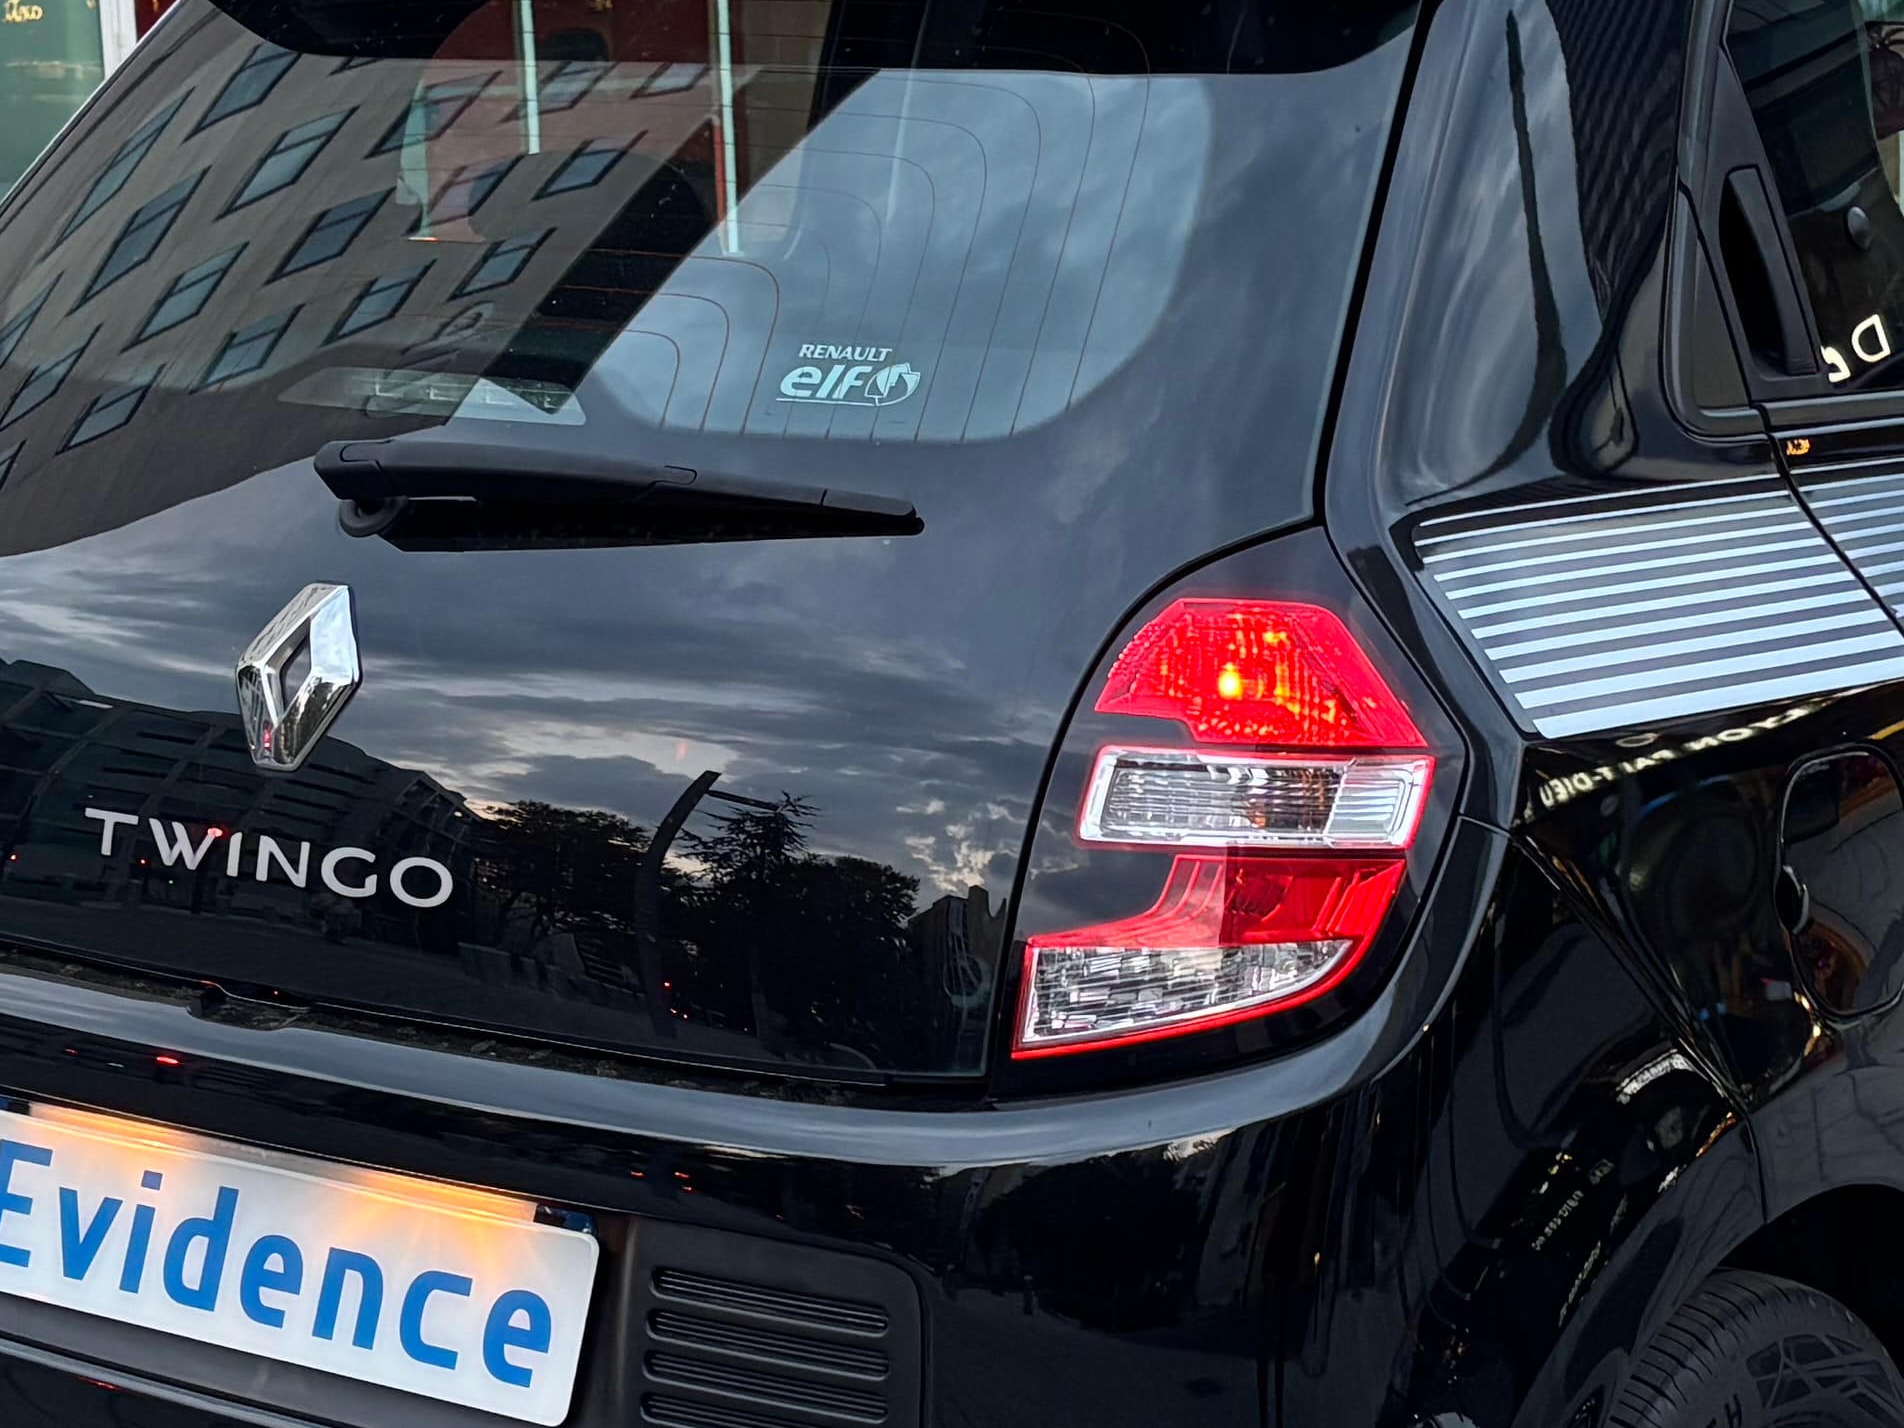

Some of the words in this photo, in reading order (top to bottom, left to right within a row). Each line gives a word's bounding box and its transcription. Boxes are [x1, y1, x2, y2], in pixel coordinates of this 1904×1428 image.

[799, 343, 892, 362] RENAULT
[779, 364, 872, 399] elf
[85, 807, 453, 908] TWINGO
